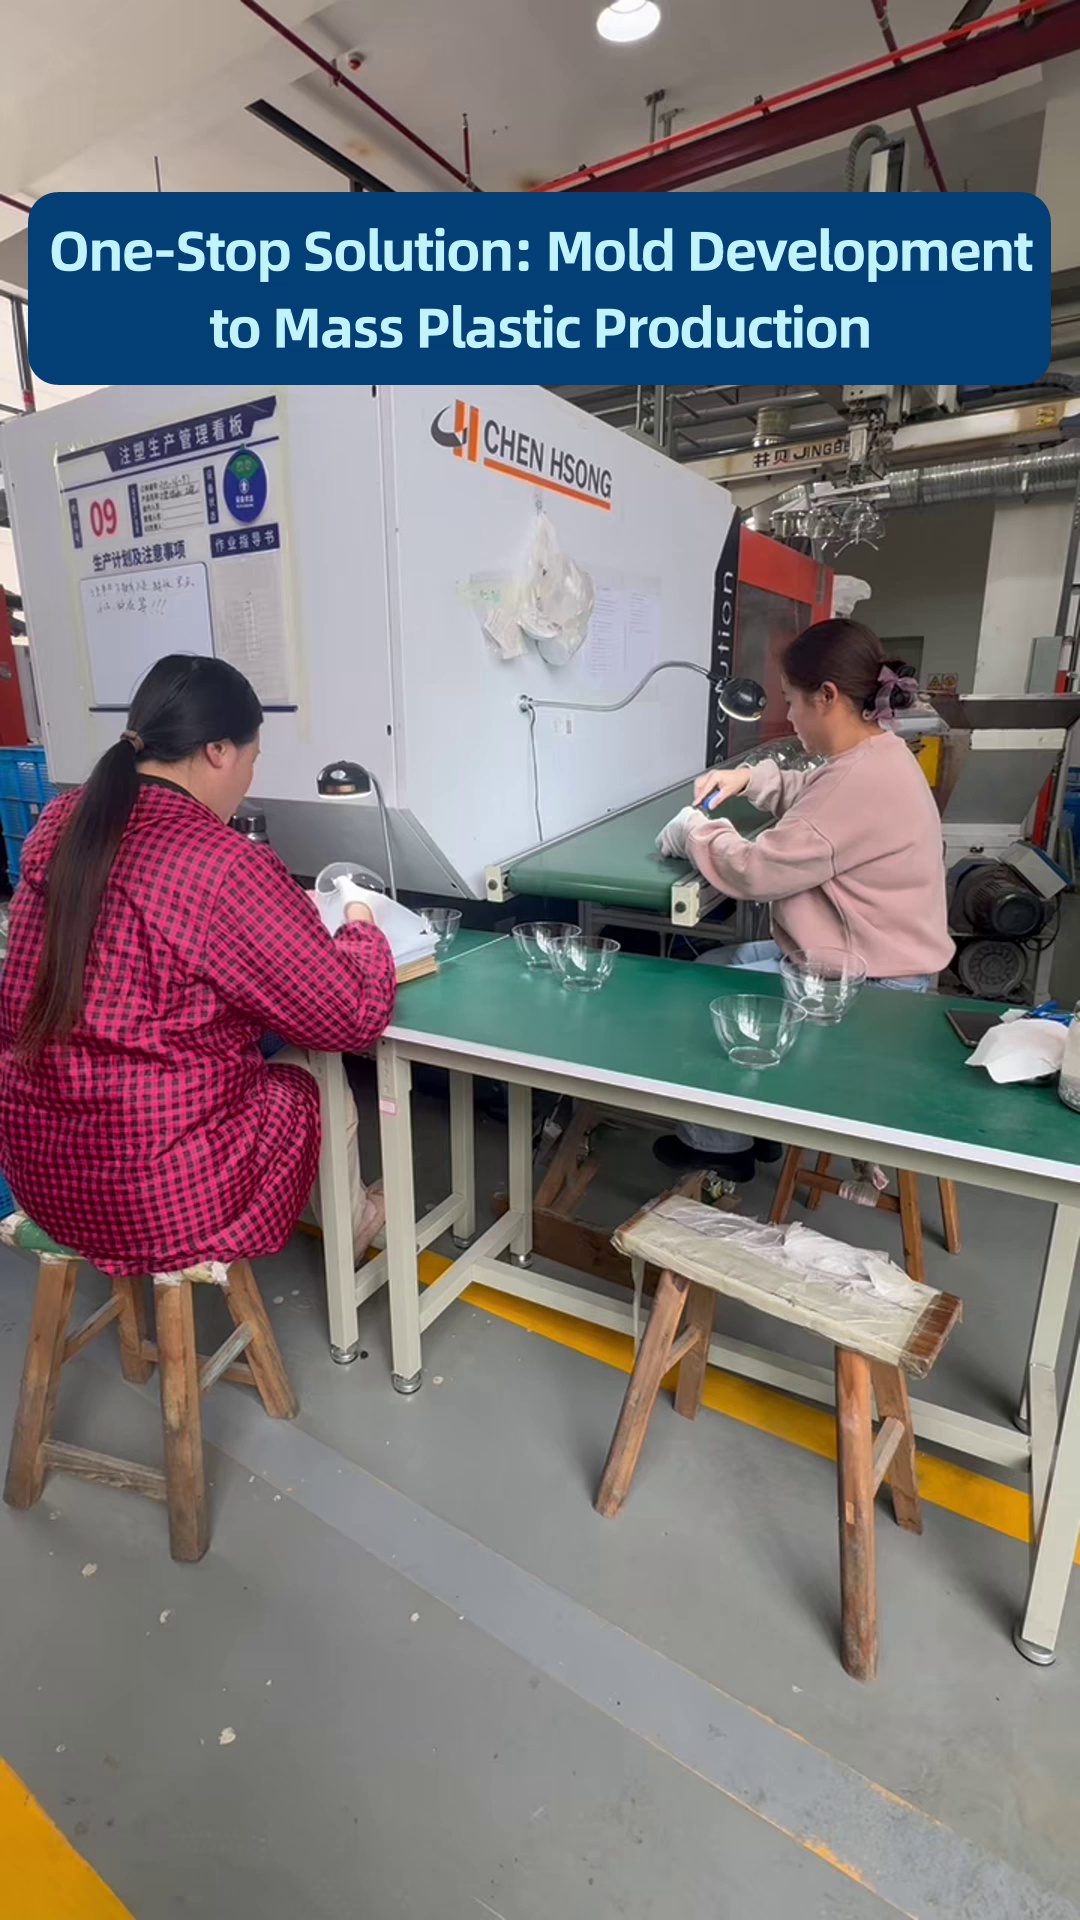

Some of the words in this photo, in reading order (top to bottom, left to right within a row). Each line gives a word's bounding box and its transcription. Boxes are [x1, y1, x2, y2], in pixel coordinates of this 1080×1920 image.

[119, 413, 245, 465] 注塑生产管理看板
[484, 420, 544, 472] CHEN
[551, 448, 612, 498] HSONG
[90, 498, 118, 537] 09
[92, 540, 187, 573] 生产计划及注意事项
[215, 530, 275, 553] 作业指导书
